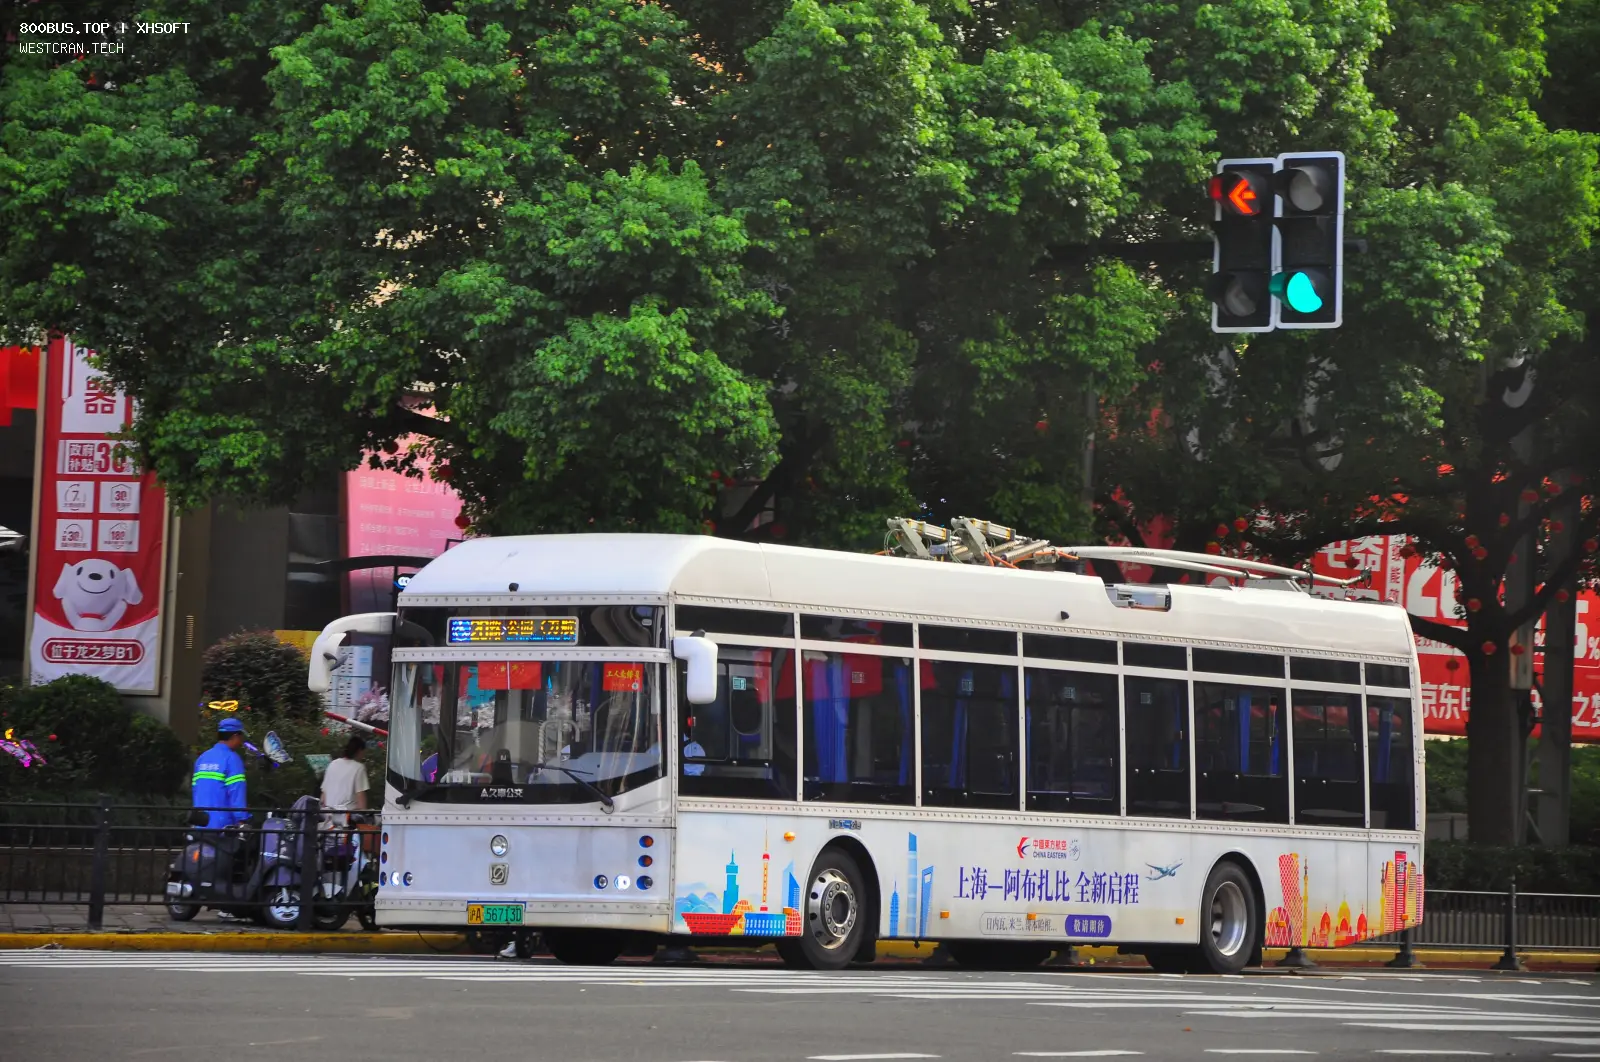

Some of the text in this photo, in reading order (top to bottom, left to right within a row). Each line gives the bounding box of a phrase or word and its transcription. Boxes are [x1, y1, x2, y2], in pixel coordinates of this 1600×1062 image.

[69, 443, 94, 457] 政府
[69, 458, 93, 472] 补贴
[51, 644, 134, 660] 位于龙之梦B1
[1033, 851, 1067, 860] CHINA EASTERN
[1074, 871, 1139, 905] 全新启程
[1073, 918, 1105, 934] 敬请期待
